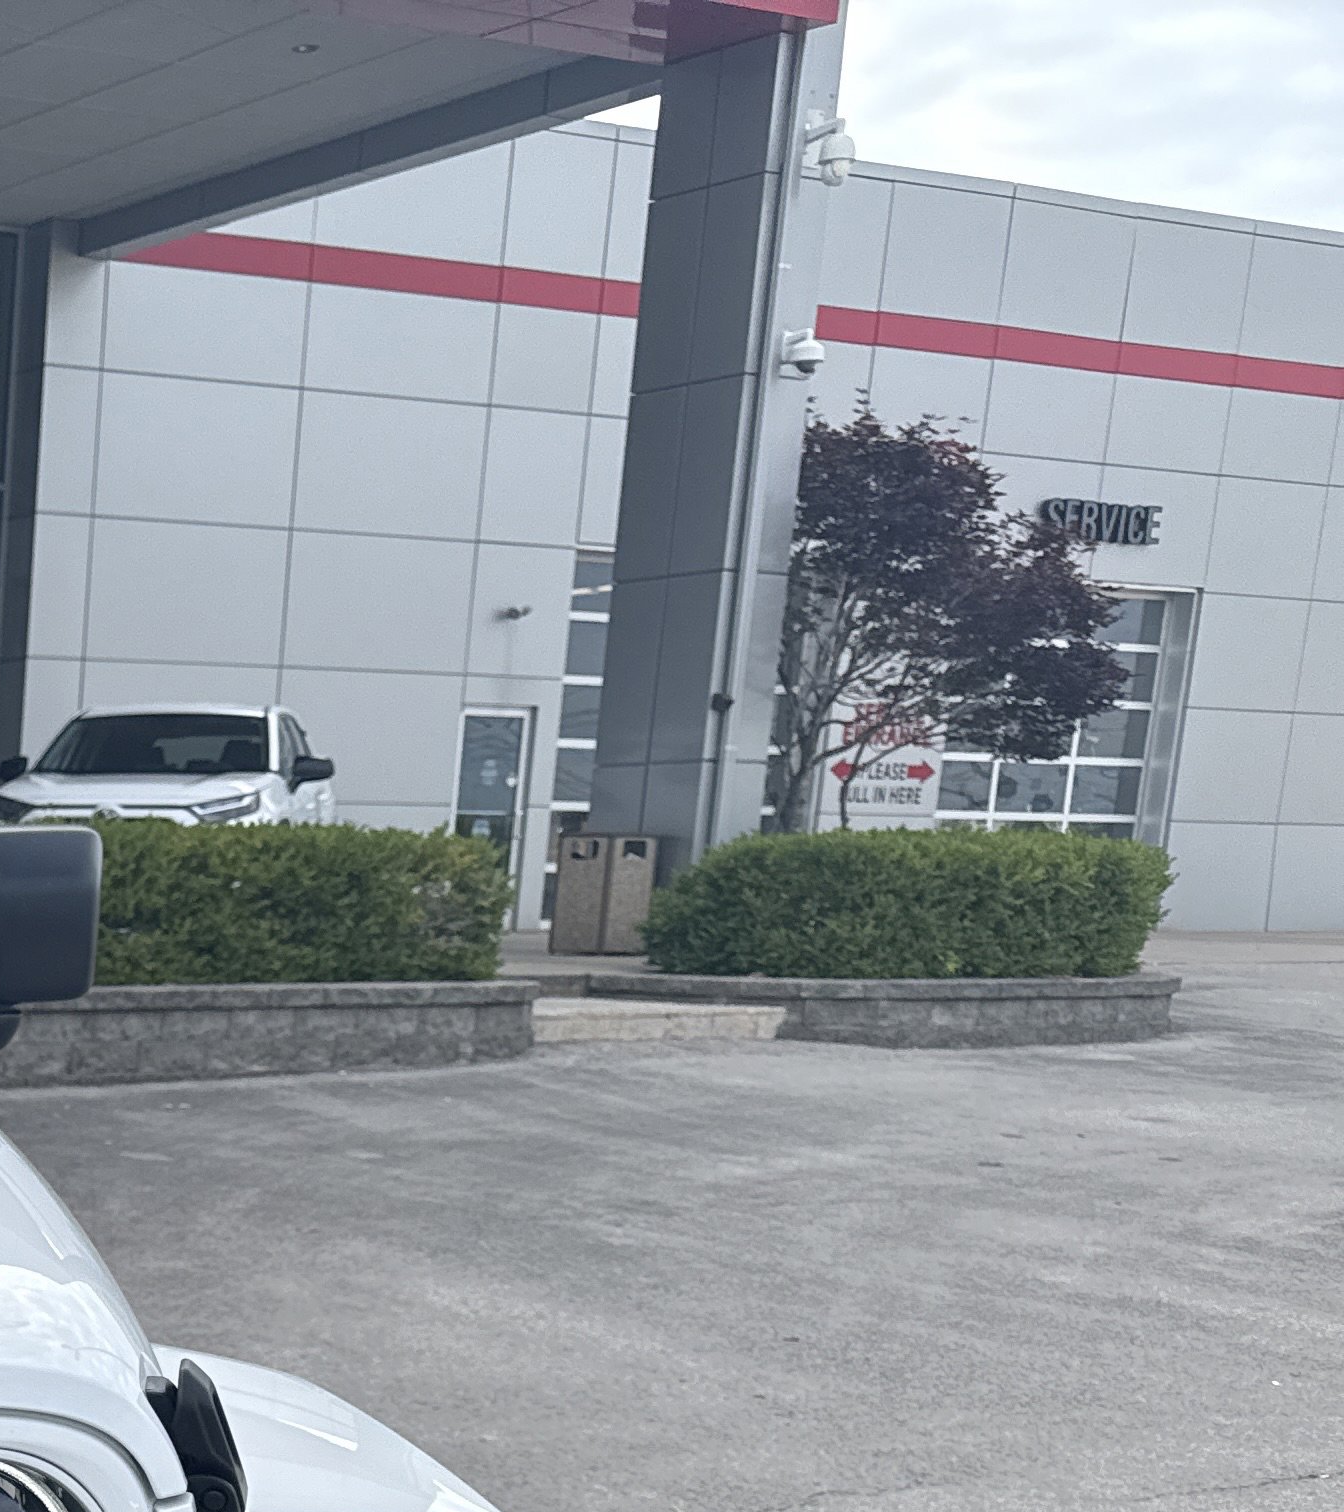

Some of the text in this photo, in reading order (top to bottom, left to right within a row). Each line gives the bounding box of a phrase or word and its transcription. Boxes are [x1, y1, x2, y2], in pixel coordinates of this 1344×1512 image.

[1043, 498, 1162, 544] SERVICE
[874, 786, 887, 802] IN
[889, 786, 922, 804] HERE
